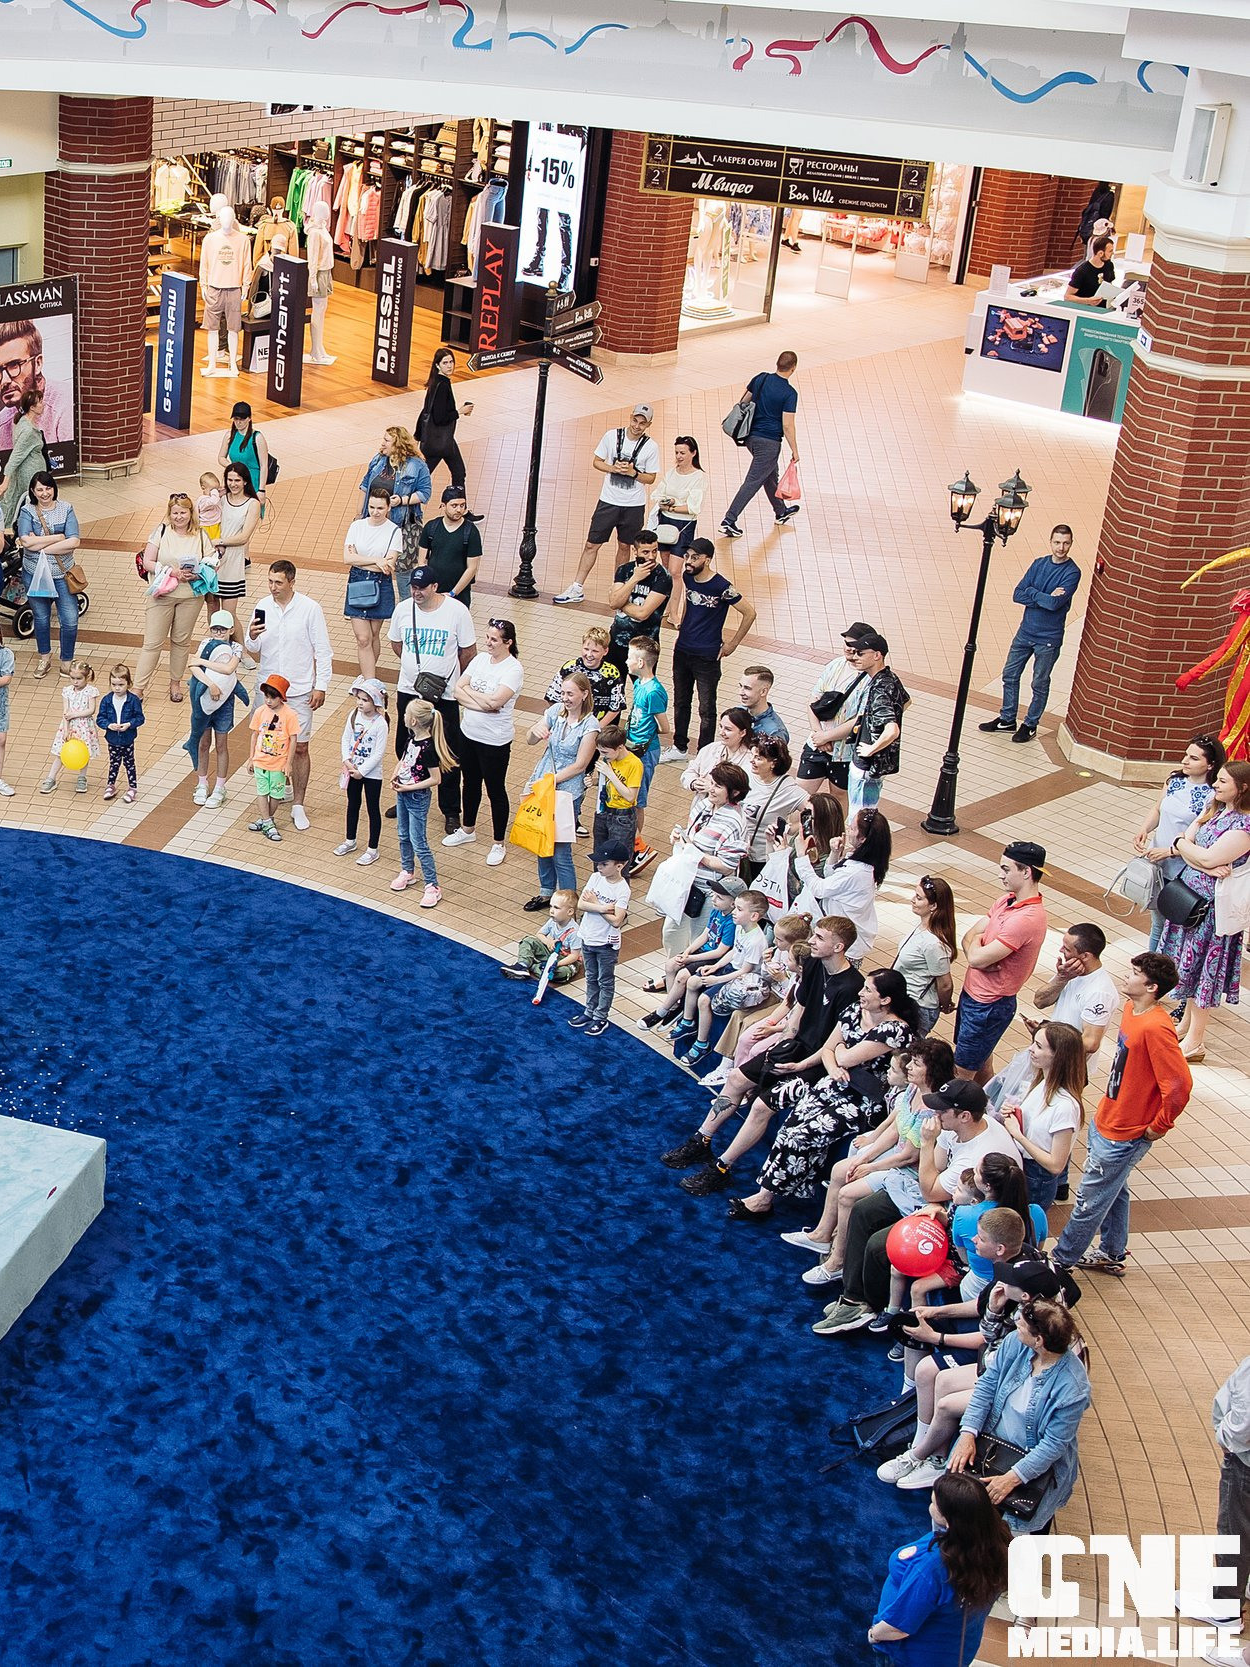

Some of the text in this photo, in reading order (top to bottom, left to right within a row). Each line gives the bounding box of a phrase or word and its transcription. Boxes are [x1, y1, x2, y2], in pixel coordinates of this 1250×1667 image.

[654, 144, 663, 157] 2
[712, 154, 777, 168] ГАЛЕРЕЯ ОБУВИ
[806, 160, 859, 173] РЕСТОРАНЫ
[534, 157, 575, 189] -15%
[652, 169, 661, 182] 2
[909, 169, 919, 183] 2
[788, 184, 835, 204] Bon Ville
[838, 198, 888, 209] СВЕЖИЕ ПРОДУКТЫ
[907, 195, 914, 209] 1
[478, 238, 504, 351] REPLAY
[39, 300, 63, 310] ОПТИКА
[376, 255, 396, 372] DIESEL
[392, 292, 401, 353] SUCCESSFUL
[163, 288, 177, 413] G-STAR RAW
